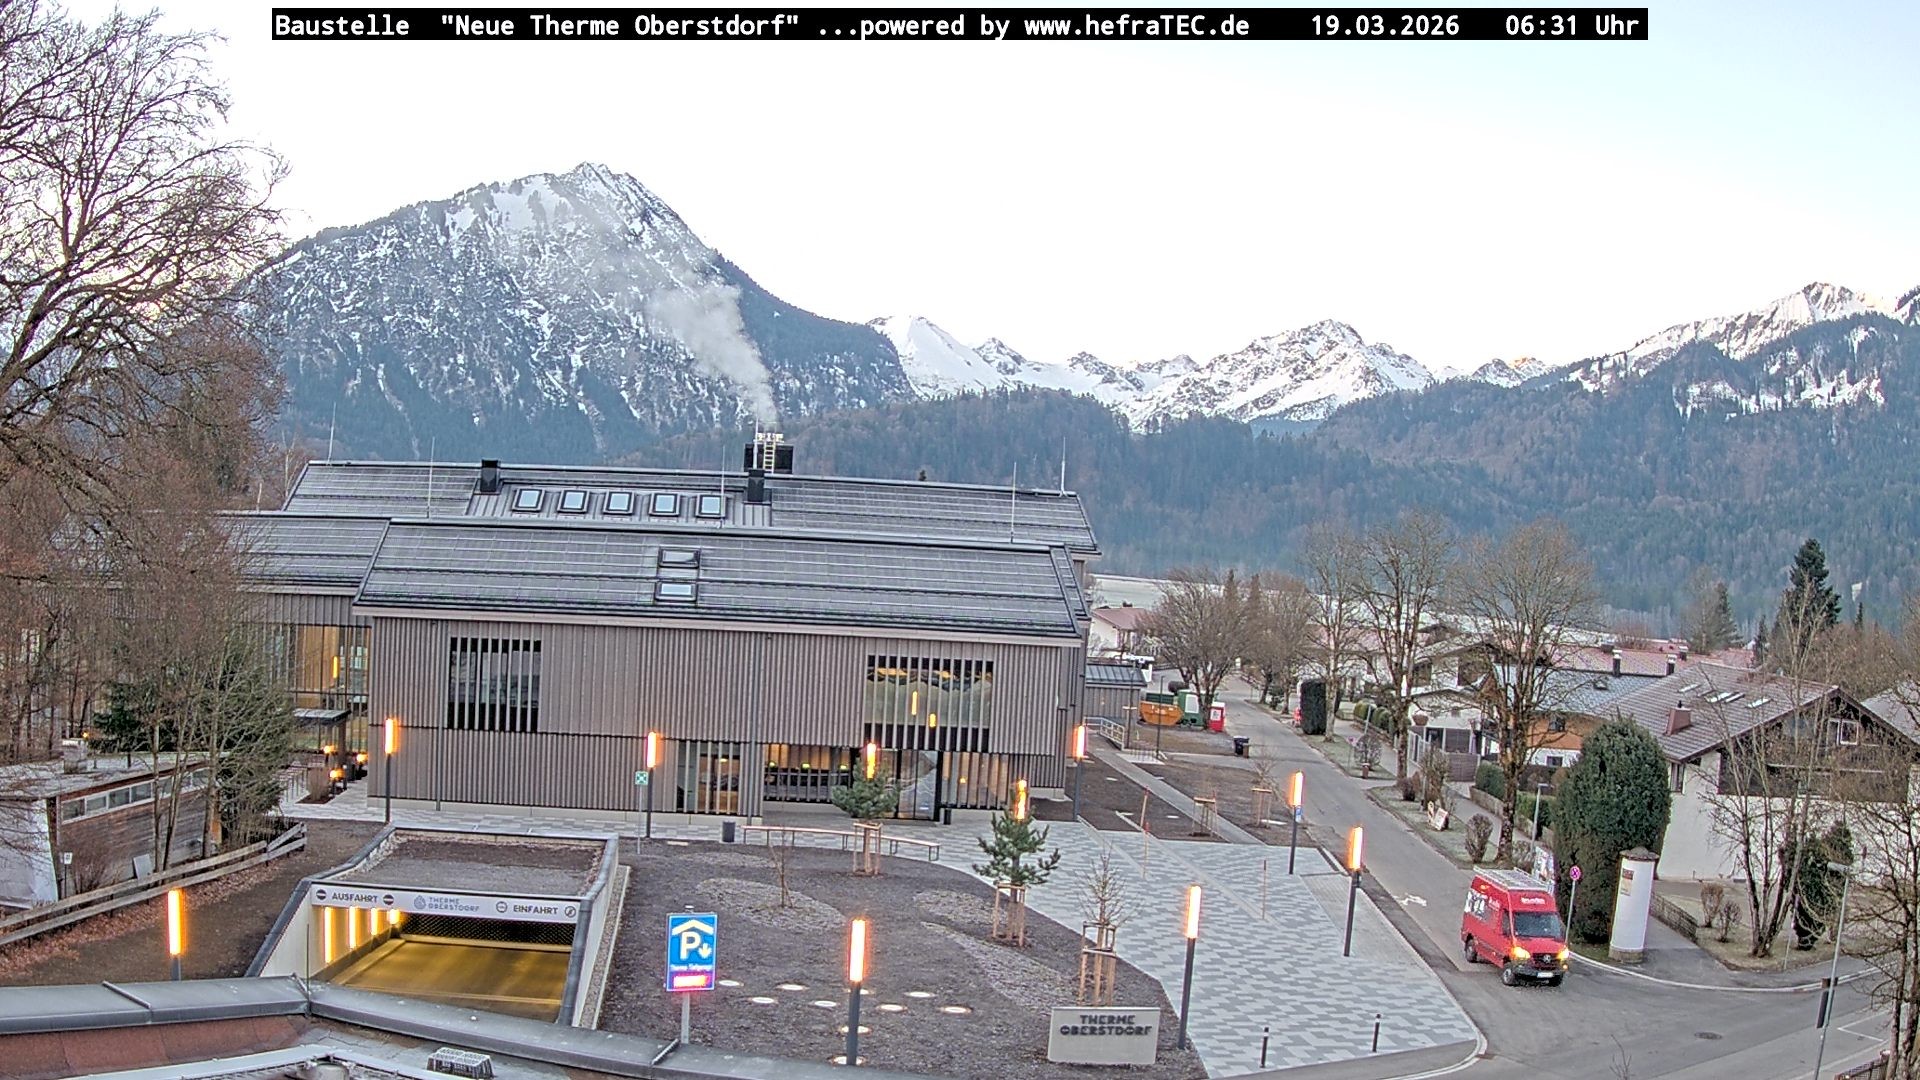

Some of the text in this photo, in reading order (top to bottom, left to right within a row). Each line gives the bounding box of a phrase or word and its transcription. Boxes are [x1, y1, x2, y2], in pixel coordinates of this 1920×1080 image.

[331, 892, 379, 904] AUSFAHRT
[513, 904, 559, 915] EINFAHRT
[680, 931, 701, 960] P
[1079, 1014, 1136, 1025] THERME
[1059, 1025, 1153, 1036] OBERSTDORF
